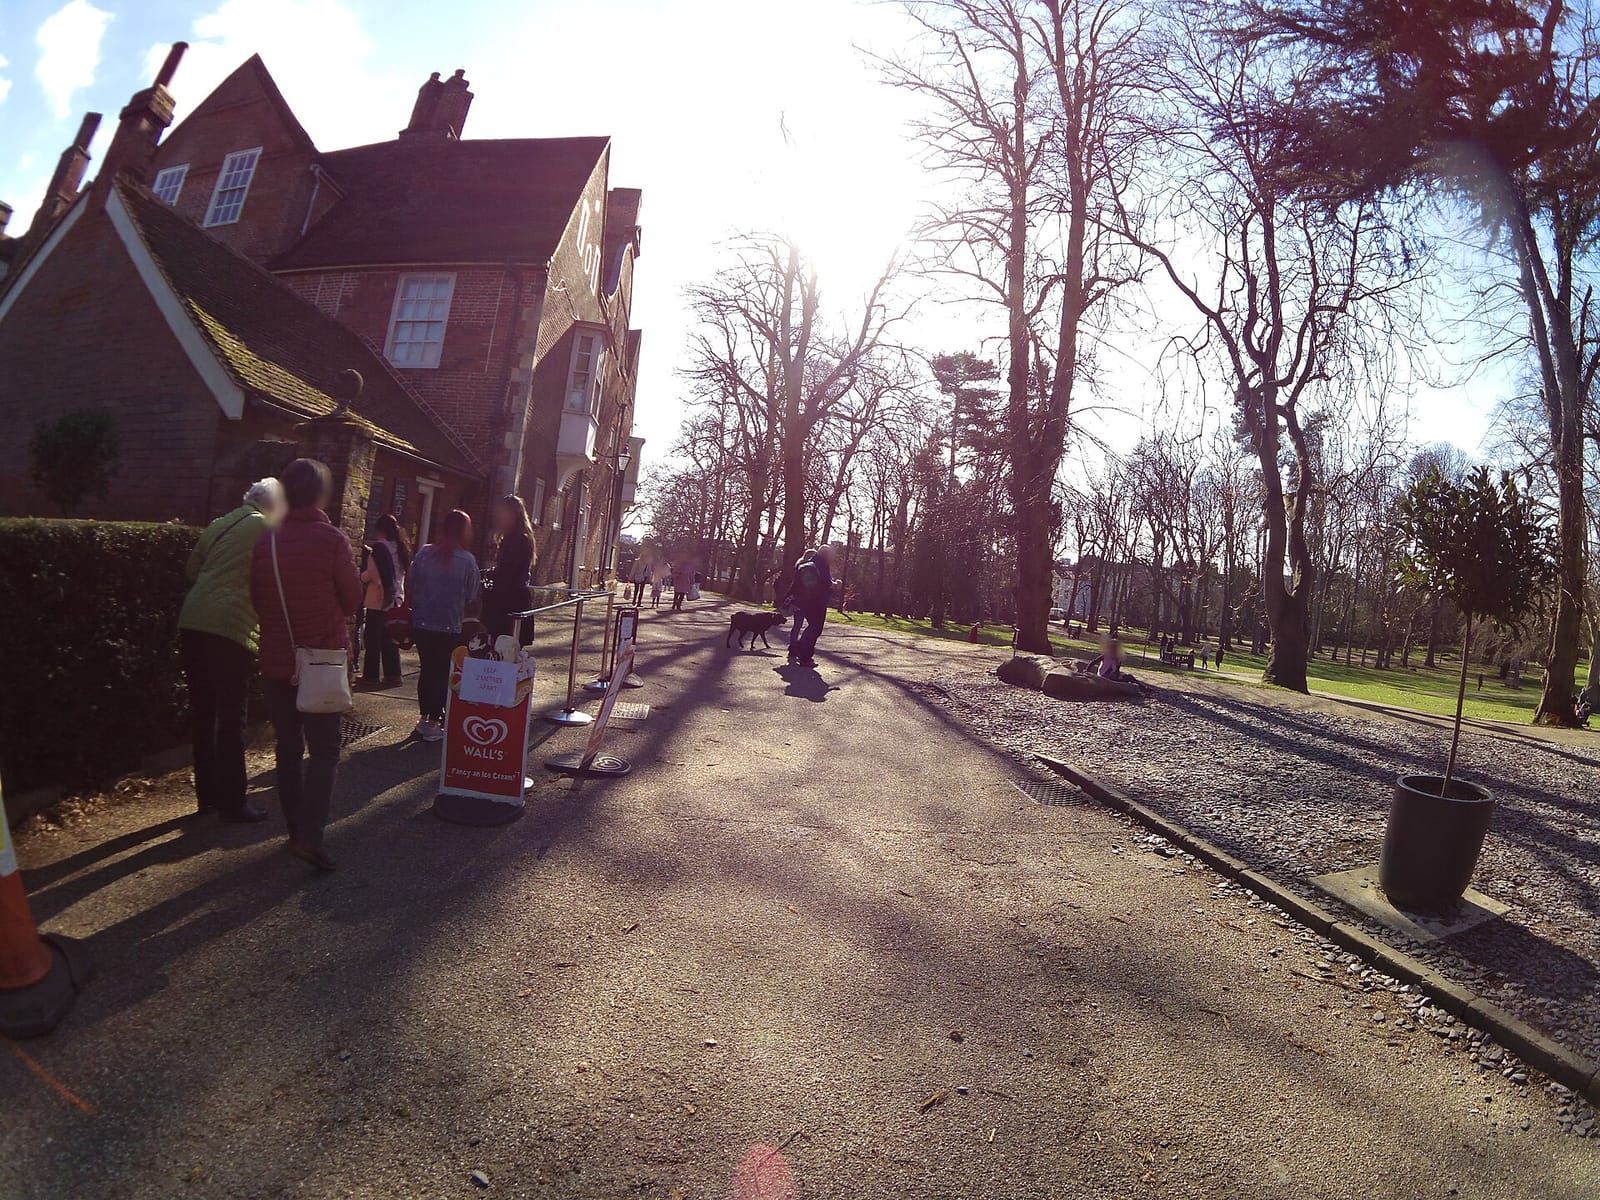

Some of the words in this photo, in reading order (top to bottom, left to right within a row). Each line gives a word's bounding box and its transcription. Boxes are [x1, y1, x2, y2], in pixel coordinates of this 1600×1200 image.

[463, 745, 504, 761] WALL'S
[451, 768, 471, 779] Fancy
[481, 771, 491, 779] Ice
